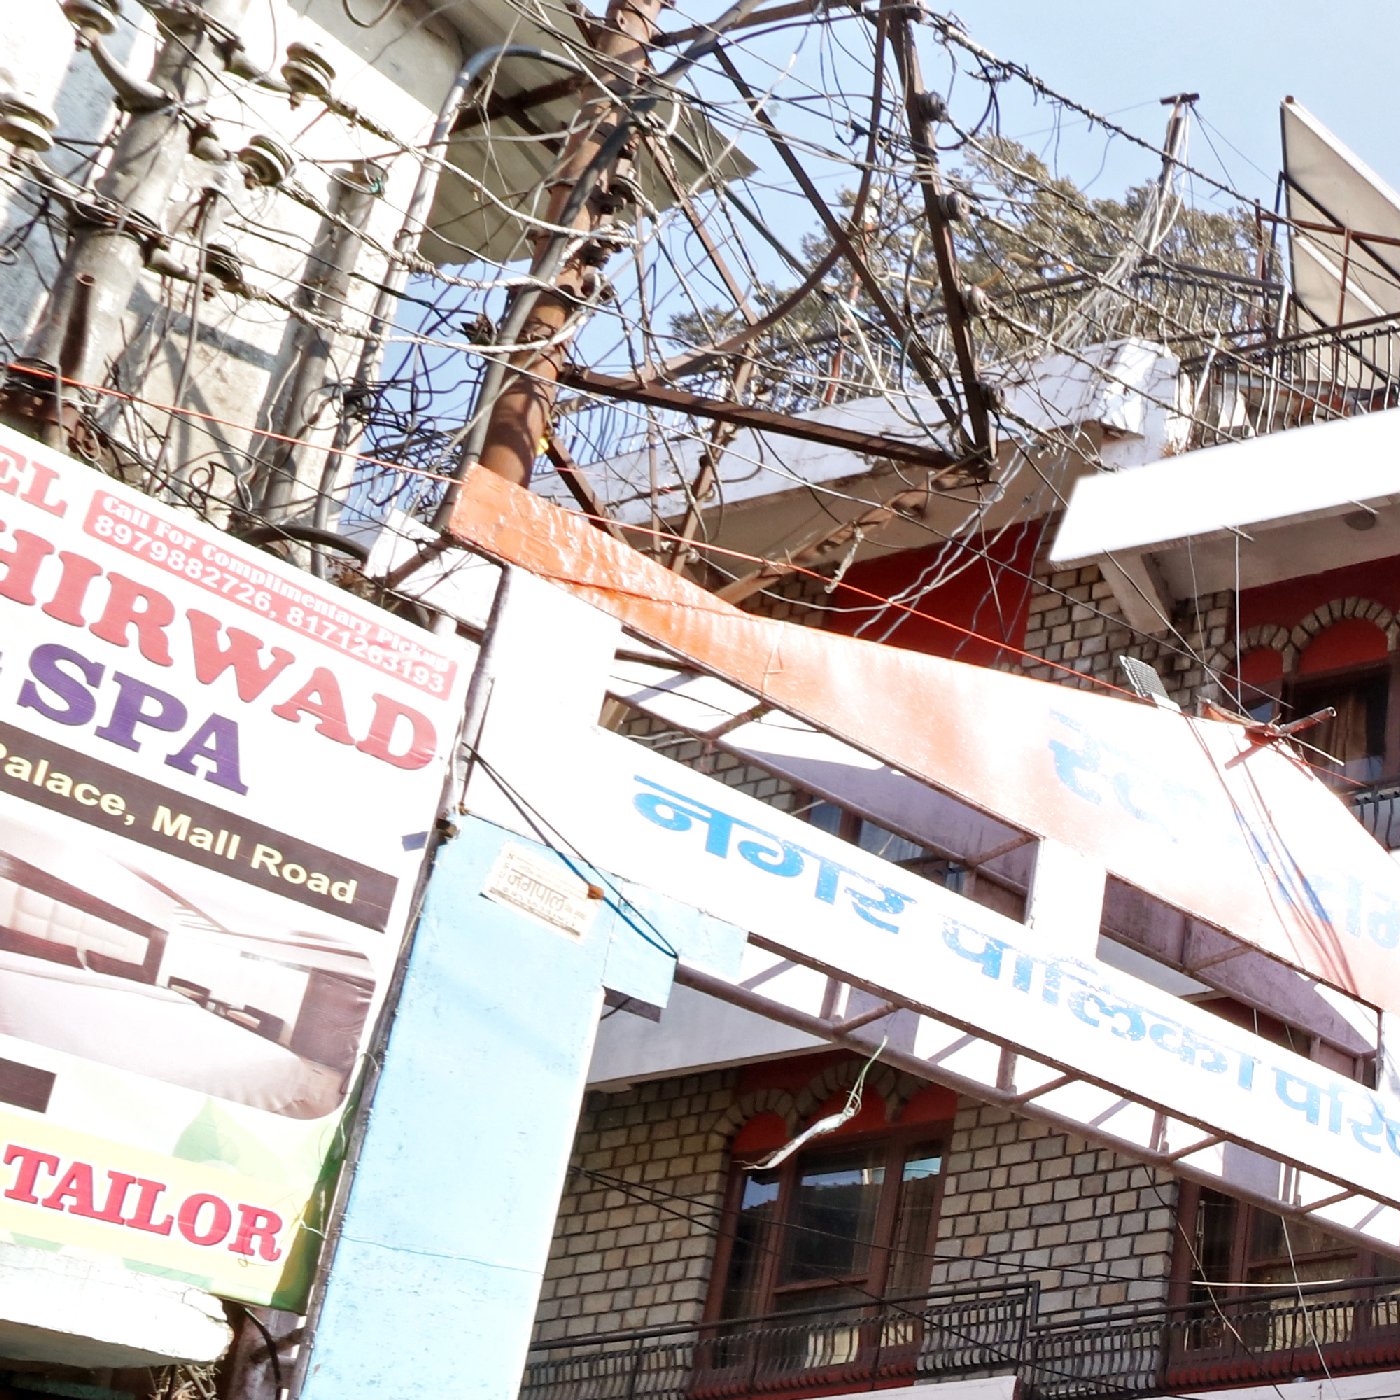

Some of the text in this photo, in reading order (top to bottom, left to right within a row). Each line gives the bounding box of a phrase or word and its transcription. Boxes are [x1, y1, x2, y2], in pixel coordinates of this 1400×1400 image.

[95, 515, 445, 692] 8979882726, 8171263193
[102, 495, 449, 673] Call For Complimentary Pickup
[17, 643, 249, 796] SPA
[152, 805, 241, 859] Mall
[251, 844, 358, 904] Road
[633, 775, 918, 934] नगर
[938, 913, 1263, 1091] पालिका
[3, 1144, 283, 1262] TAILOR
